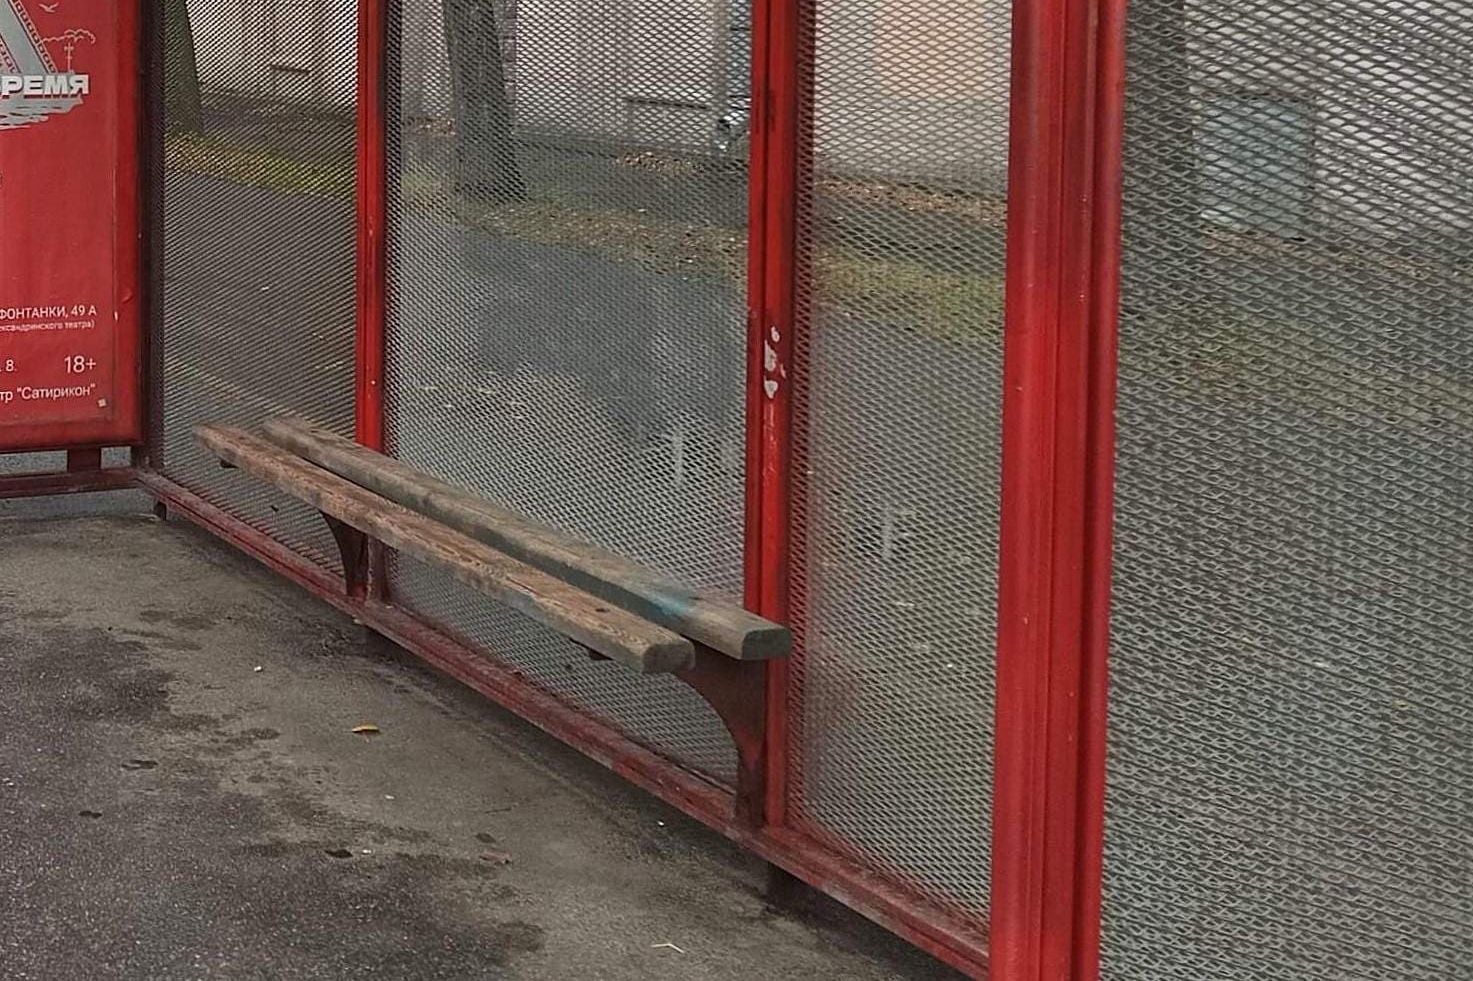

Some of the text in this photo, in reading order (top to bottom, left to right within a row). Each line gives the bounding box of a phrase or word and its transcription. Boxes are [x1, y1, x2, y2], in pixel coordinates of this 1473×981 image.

[71, 305, 85, 316] 49
[63, 355, 97, 374] 18+
[16, 383, 96, 402] "Сатирикон"
